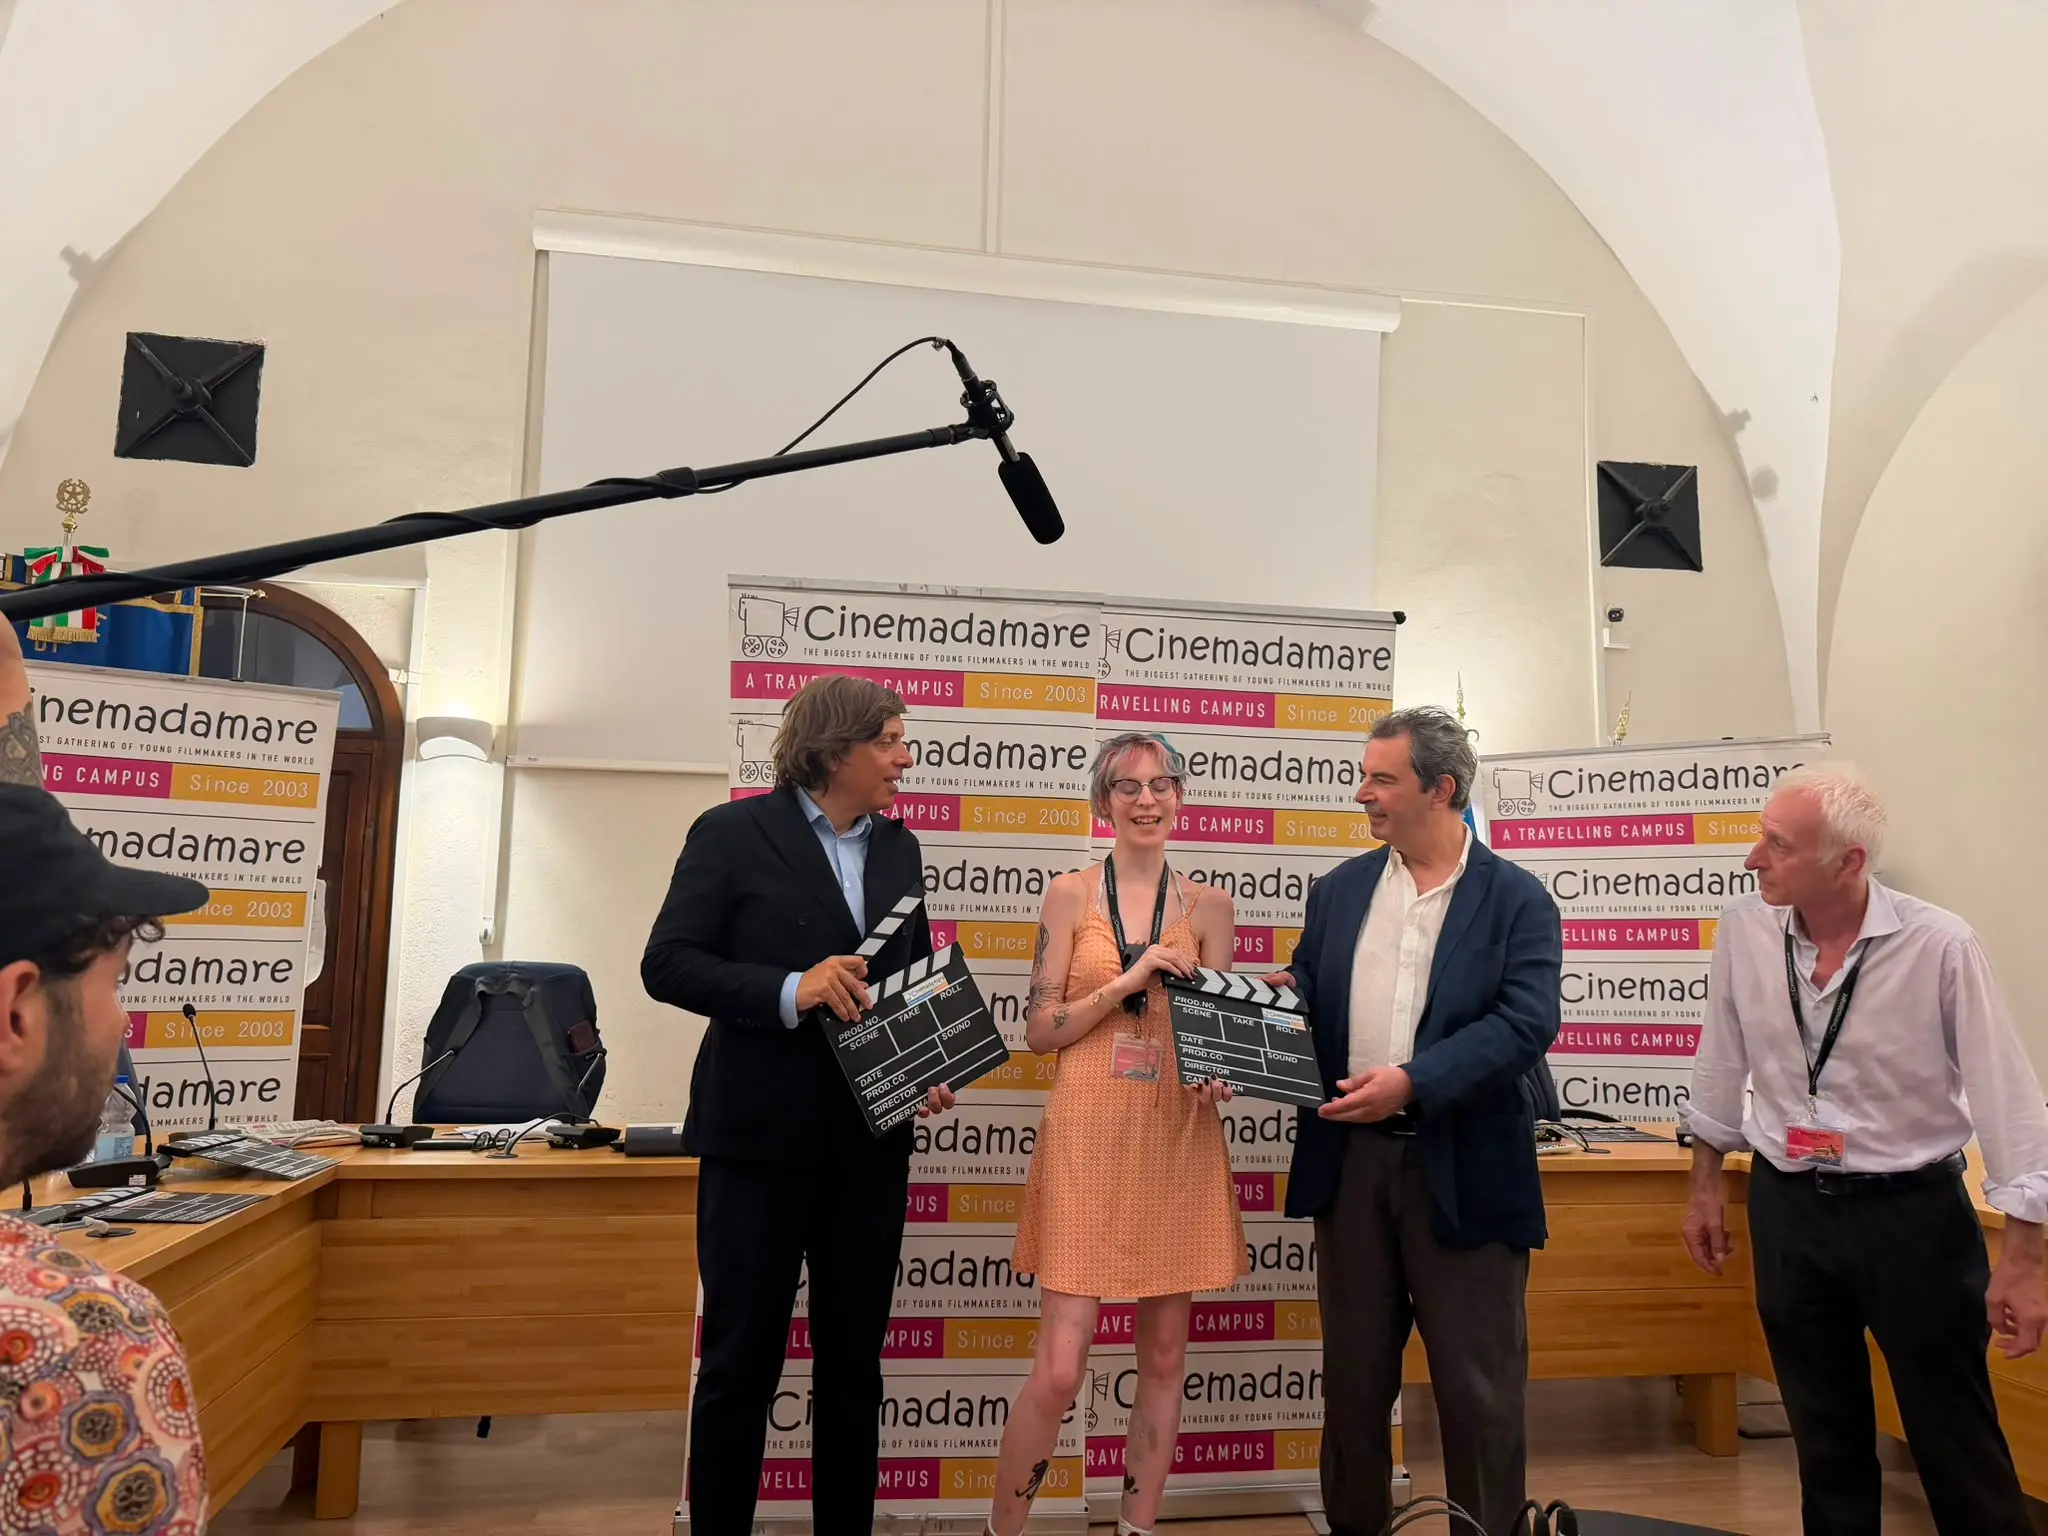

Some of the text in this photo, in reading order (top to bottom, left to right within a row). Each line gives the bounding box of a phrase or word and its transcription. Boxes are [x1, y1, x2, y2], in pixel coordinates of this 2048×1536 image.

[804, 605, 1091, 649] Cinemadamare
[804, 648, 1090, 669] THE BIGGEST GATHERING OF YOUNG FILMMAKERS IN THE WORLD
[1126, 627, 1391, 672] Cinemadamare
[745, 673, 754, 688] A
[980, 682, 1032, 700] Since
[1045, 685, 1086, 702] 2003
[1125, 669, 1141, 678] THE
[1145, 670, 1179, 680] BIGGEST
[1184, 671, 1229, 683] GATHERING
[1234, 675, 1242, 683] OF
[1247, 676, 1274, 685] YOUNG
[1278, 677, 1331, 688] FILMMAKERS
[1348, 681, 1362, 690] THE
[1366, 682, 1391, 692] WORLD
[30, 687, 318, 744] nemadamare
[1100, 694, 1190, 714] RAVELLING
[1201, 700, 1265, 718] CAMPUS
[1287, 705, 1337, 722] Since
[57, 737, 116, 749] GATHERING
[122, 741, 133, 750] OF
[140, 743, 172, 754] YOUNG
[178, 746, 242, 759] FILMMAKERS
[247, 752, 256, 760] IN
[262, 752, 278, 762] THE
[284, 755, 314, 765] WORLD
[901, 734, 1087, 771] madamare
[1179, 750, 1365, 786] emadama
[77, 768, 160, 787] CAMPUS
[190, 774, 250, 794] Since
[263, 780, 308, 798] 2003
[916, 777, 925, 785] OF
[931, 777, 959, 787] YOUNG
[964, 778, 1020, 789] FILMMAKERS
[1025, 780, 1033, 790] IN
[1039, 781, 1054, 790] THE
[1059, 782, 1086, 792] WORLD
[1183, 789, 1228, 798] GATHERING
[1232, 791, 1241, 799] OF
[1246, 792, 1272, 800] YOUNG
[1277, 794, 1330, 803] FILMMAKERS
[1567, 803, 1599, 811] BIGGEST
[1604, 801, 1647, 810] GATHERING
[1695, 798, 1747, 806] FILMMAKERS
[884, 804, 950, 821] AMPUS
[973, 807, 1027, 825] Since
[1039, 809, 1080, 826] 2003
[1200, 817, 1264, 833] CAMPUS
[1286, 821, 1337, 837] Since
[1503, 821, 1759, 842] A TRAVELLING CAMPUS Since
[86, 827, 305, 864] madamare
[250, 874, 265, 882] THE
[1553, 867, 1755, 900] Cinemadam
[247, 902, 292, 918] 2003
[927, 904, 1031, 914] YOUNG FILMMAKERS IN
[1245, 910, 1271, 918] YOUNG
[1572, 905, 1604, 914] BIGGEST
[1608, 905, 1653, 913] GATHERING
[973, 932, 1027, 950] Since
[1563, 928, 1690, 942] ELLING CAMPUS
[1560, 972, 1708, 1003] Cinemad
[121, 995, 147, 1003] OUNG
[153, 995, 216, 1003] FILMMAKERS
[1175, 995, 1217, 1010] PROD.NO.
[850, 984, 963, 1051] SCENE TAKE ROLL
[1182, 1007, 1299, 1036] SCENE TAKE ROLL
[238, 1021, 284, 1037] 2003
[838, 1015, 882, 1042] PROD.NO.
[1180, 1035, 1298, 1064] DATE SOUND
[1553, 1032, 1695, 1048] VELLING CAMPUS
[859, 1020, 972, 1088] DATE SOUND
[1182, 1047, 1225, 1062] PROD.CO.
[1184, 1061, 1230, 1076] DIRECTOR
[865, 1074, 908, 1101] PROD.CO.
[1562, 1077, 1690, 1108] Cinema
[873, 1086, 918, 1116] DIRECTOR
[151, 1118, 204, 1127] LMMAKERS
[880, 1099, 928, 1132] CAMERAMA
[1619, 1115, 1662, 1123] GATHERING
[918, 1166, 1025, 1175] YOUNG FILMMAKERS IN
[960, 1195, 1015, 1213] Since
[1245, 1283, 1272, 1292] YOUNG
[897, 1299, 1022, 1308] OF YOUNG FILMMAKERS IN
[1196, 1313, 1264, 1331] CAMPUS
[883, 1331, 1014, 1348] MPUS Since
[1114, 1411, 1325, 1426] THE ATHERING OF YOUNG FILMMAKE
[767, 1439, 1001, 1449] THE OF YOUNG FILMMAKER
[1194, 1443, 1264, 1462] CAMPUS
